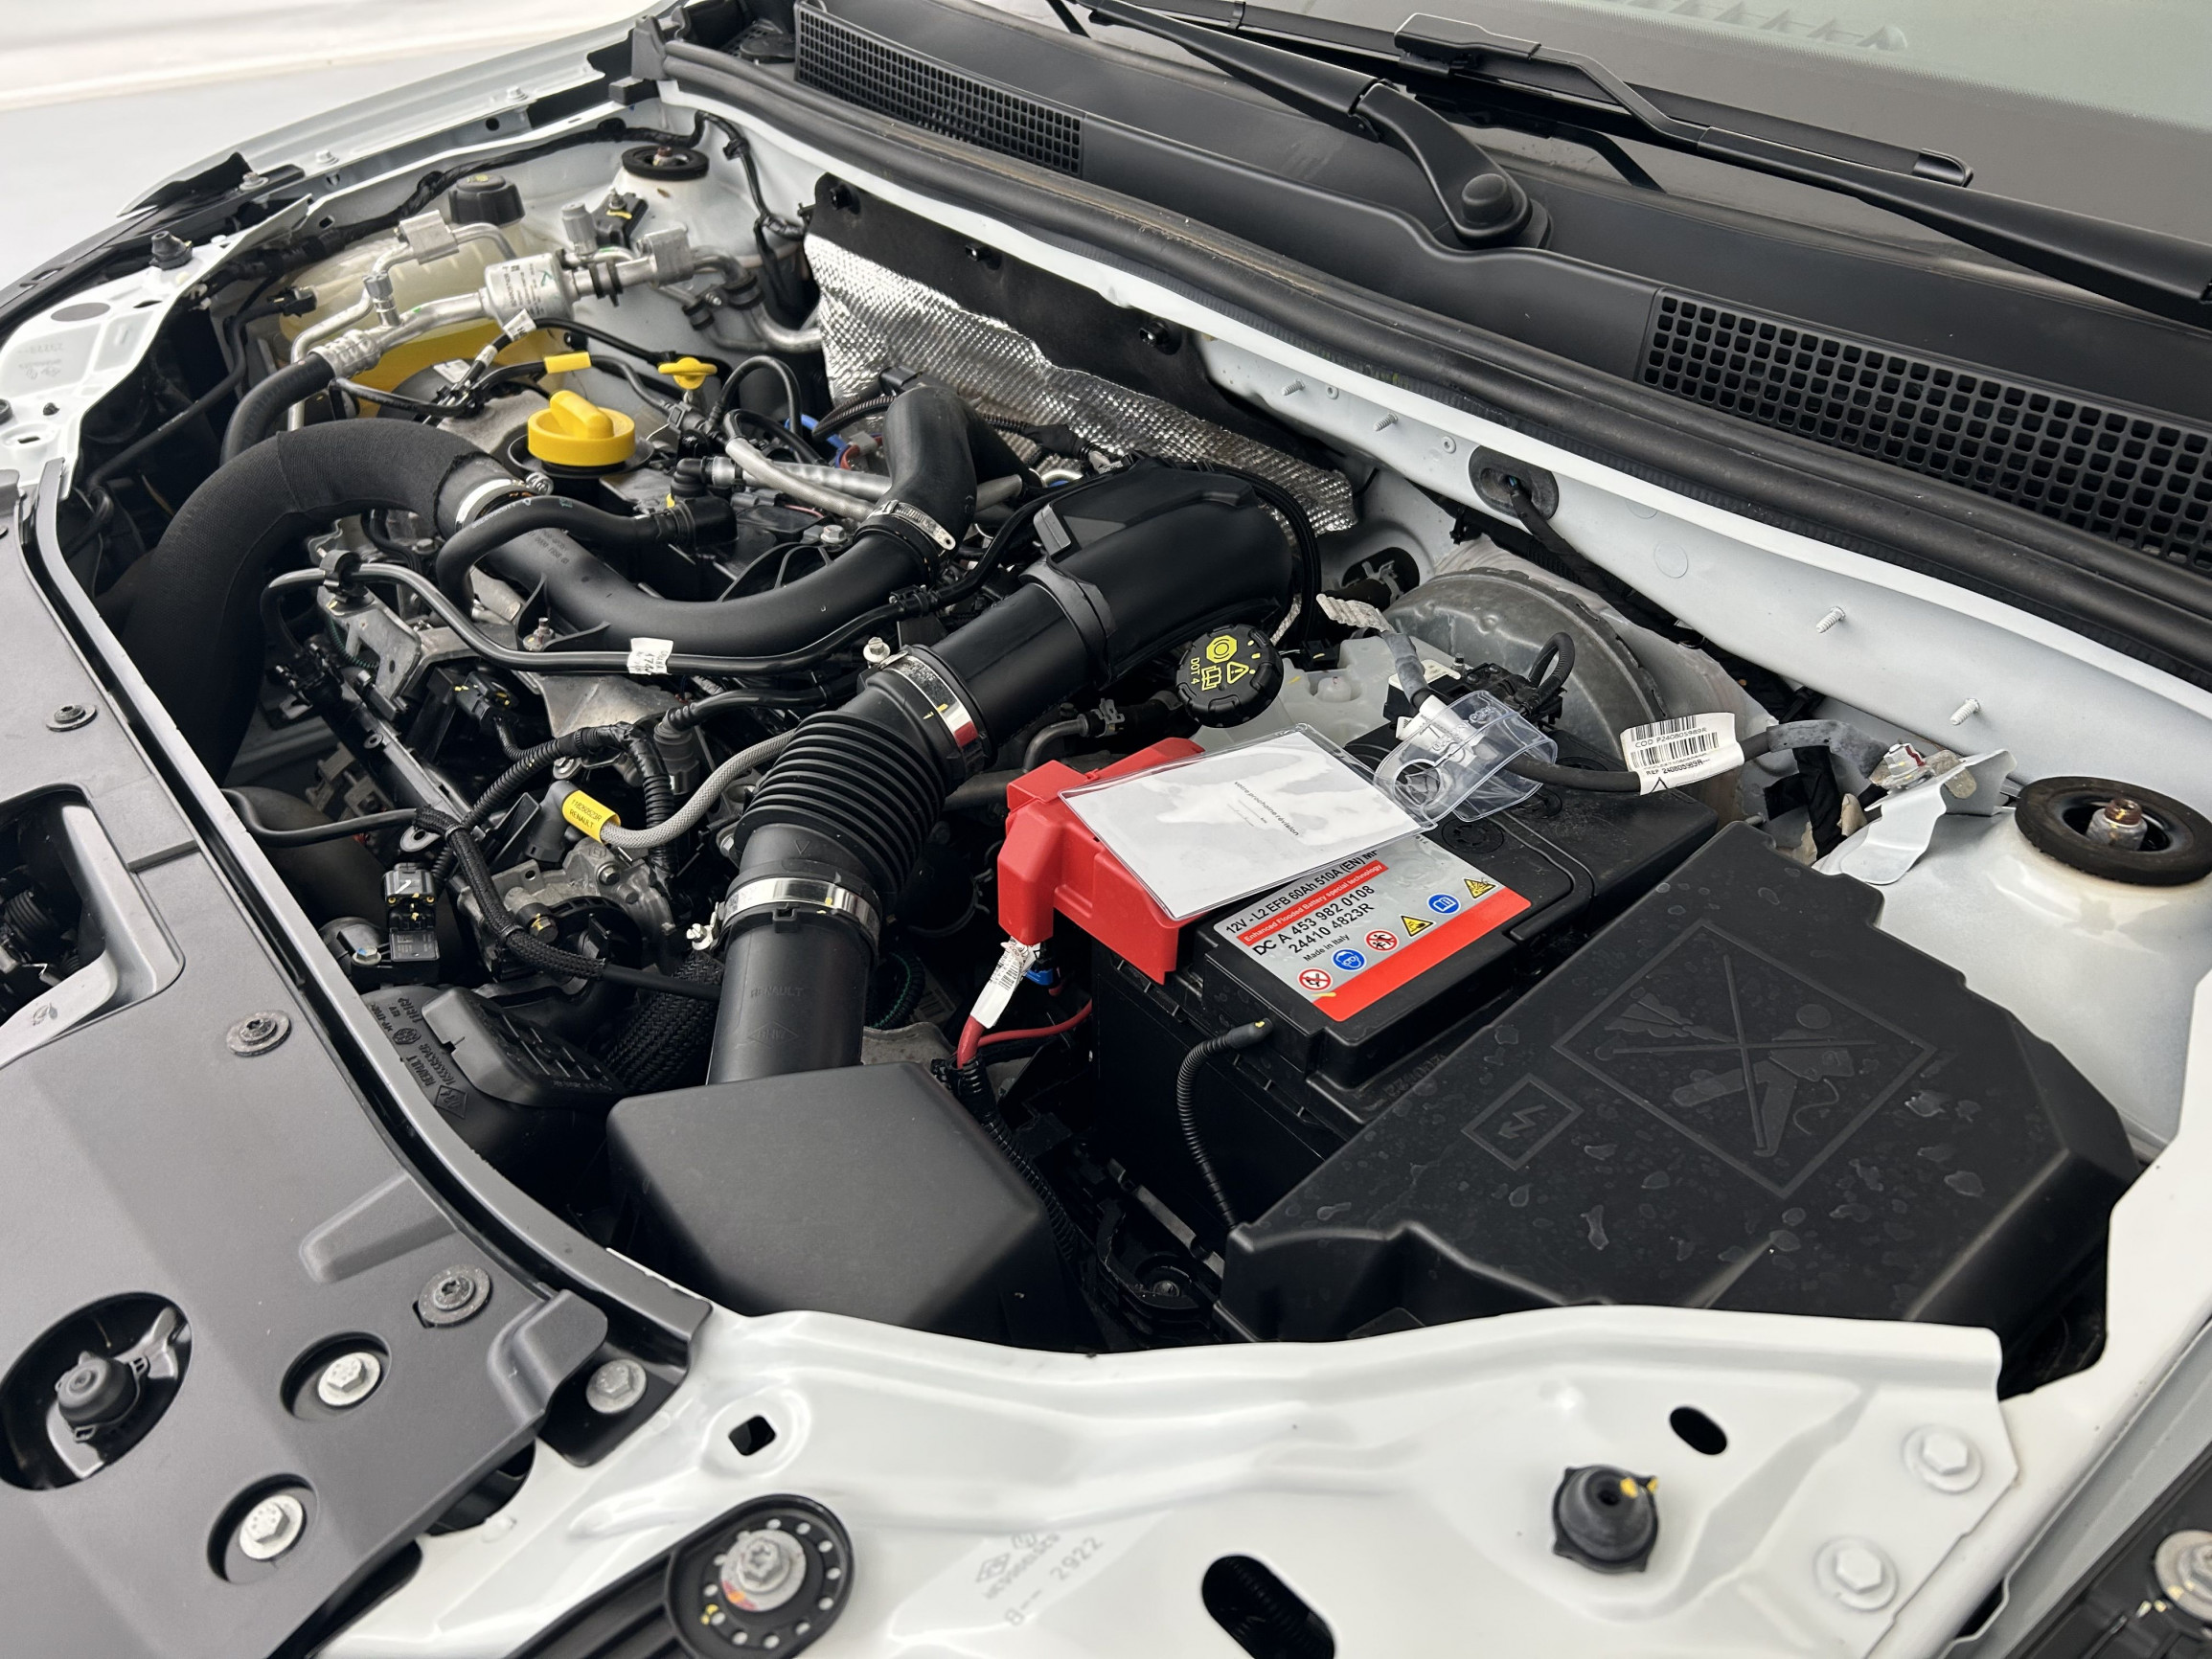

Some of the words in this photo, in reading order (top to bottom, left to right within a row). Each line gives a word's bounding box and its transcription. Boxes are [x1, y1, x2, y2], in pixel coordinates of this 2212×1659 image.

[1191, 657, 1201, 675] DOT
[1635, 739, 1653, 748] COD
[569, 808, 595, 830] RENAULT
[1226, 919, 1247, 934] 12V
[1251, 908, 1269, 920] L2
[1266, 897, 1291, 912] EFB
[1288, 883, 1318, 899] 60Ah
[1313, 869, 1344, 885] 510A
[1339, 856, 1366, 873] (EN)
[1244, 921, 1278, 942] Enhanced
[1275, 906, 1304, 924] Flooded
[1302, 895, 1328, 910] Battery
[1325, 882, 1349, 898] special
[1347, 864, 1382, 885] technology
[1252, 940, 1277, 956] DC
[1278, 933, 1292, 943] A
[1291, 918, 1317, 935] 453
[1315, 903, 1344, 920] 982
[1341, 885, 1376, 906] 0108
[1288, 926, 1332, 953] 24410
[1332, 903, 1375, 928] 4823R
[1303, 948, 1325, 962] Made
[1331, 934, 1350, 945] Italy
[405, 1055, 437, 1087] RENAULT
